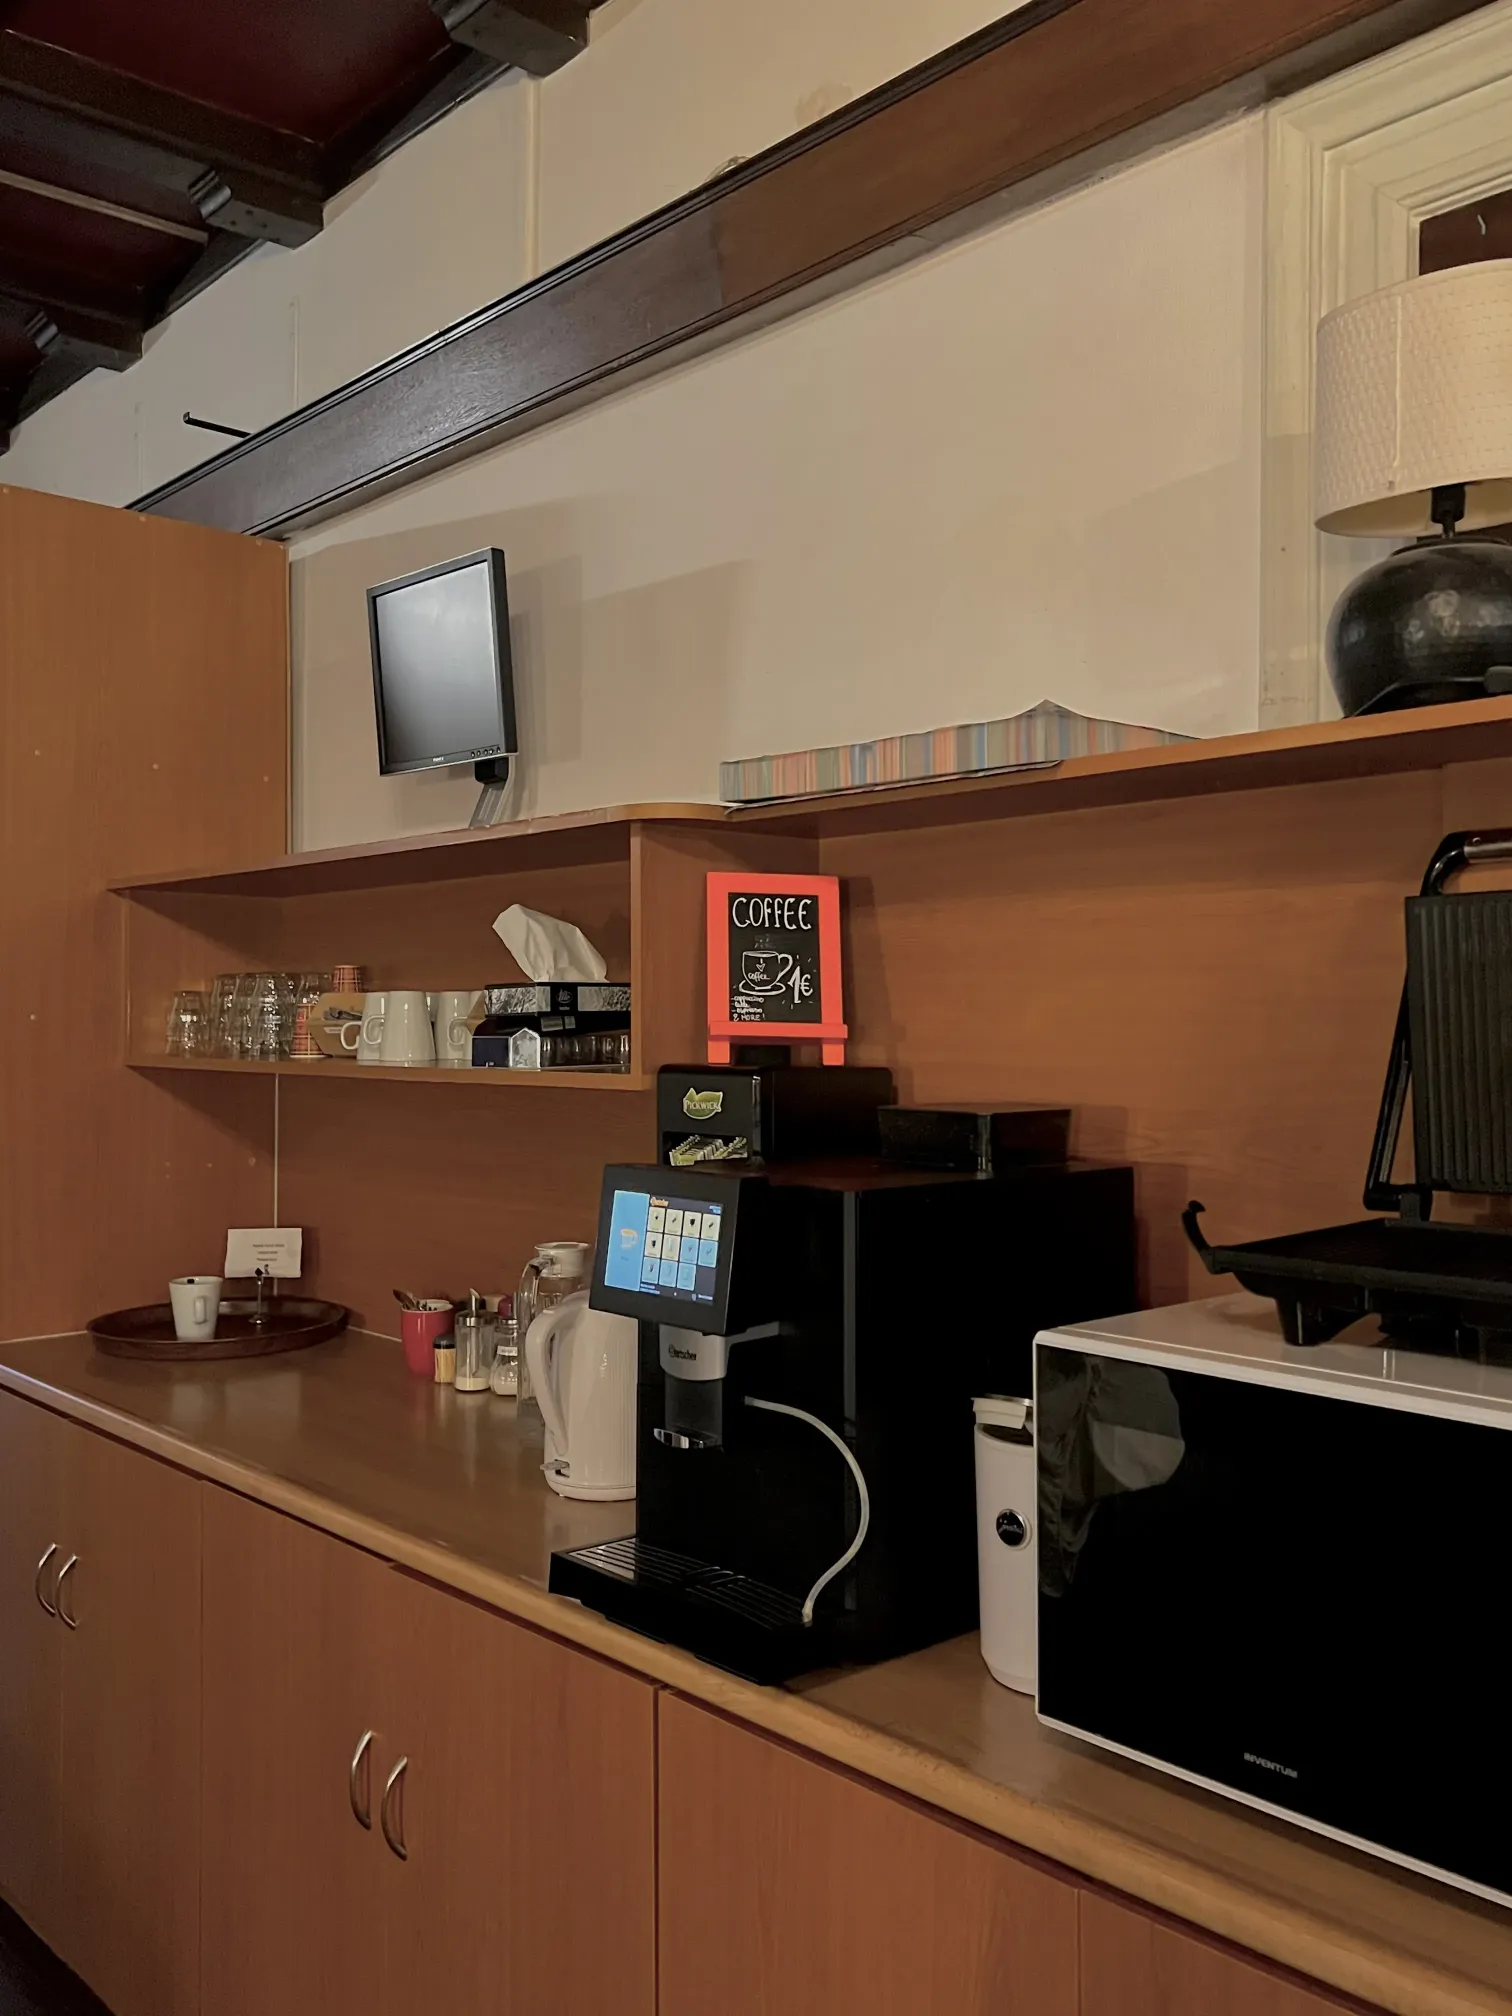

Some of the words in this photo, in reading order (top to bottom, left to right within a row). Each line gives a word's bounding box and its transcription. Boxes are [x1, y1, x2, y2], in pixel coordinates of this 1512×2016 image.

[732, 897, 812, 930] COFFEE
[748, 971, 771, 982] coffee
[686, 1101, 718, 1110] PICKWICK
[1243, 1752, 1298, 1778] INVENTUM
